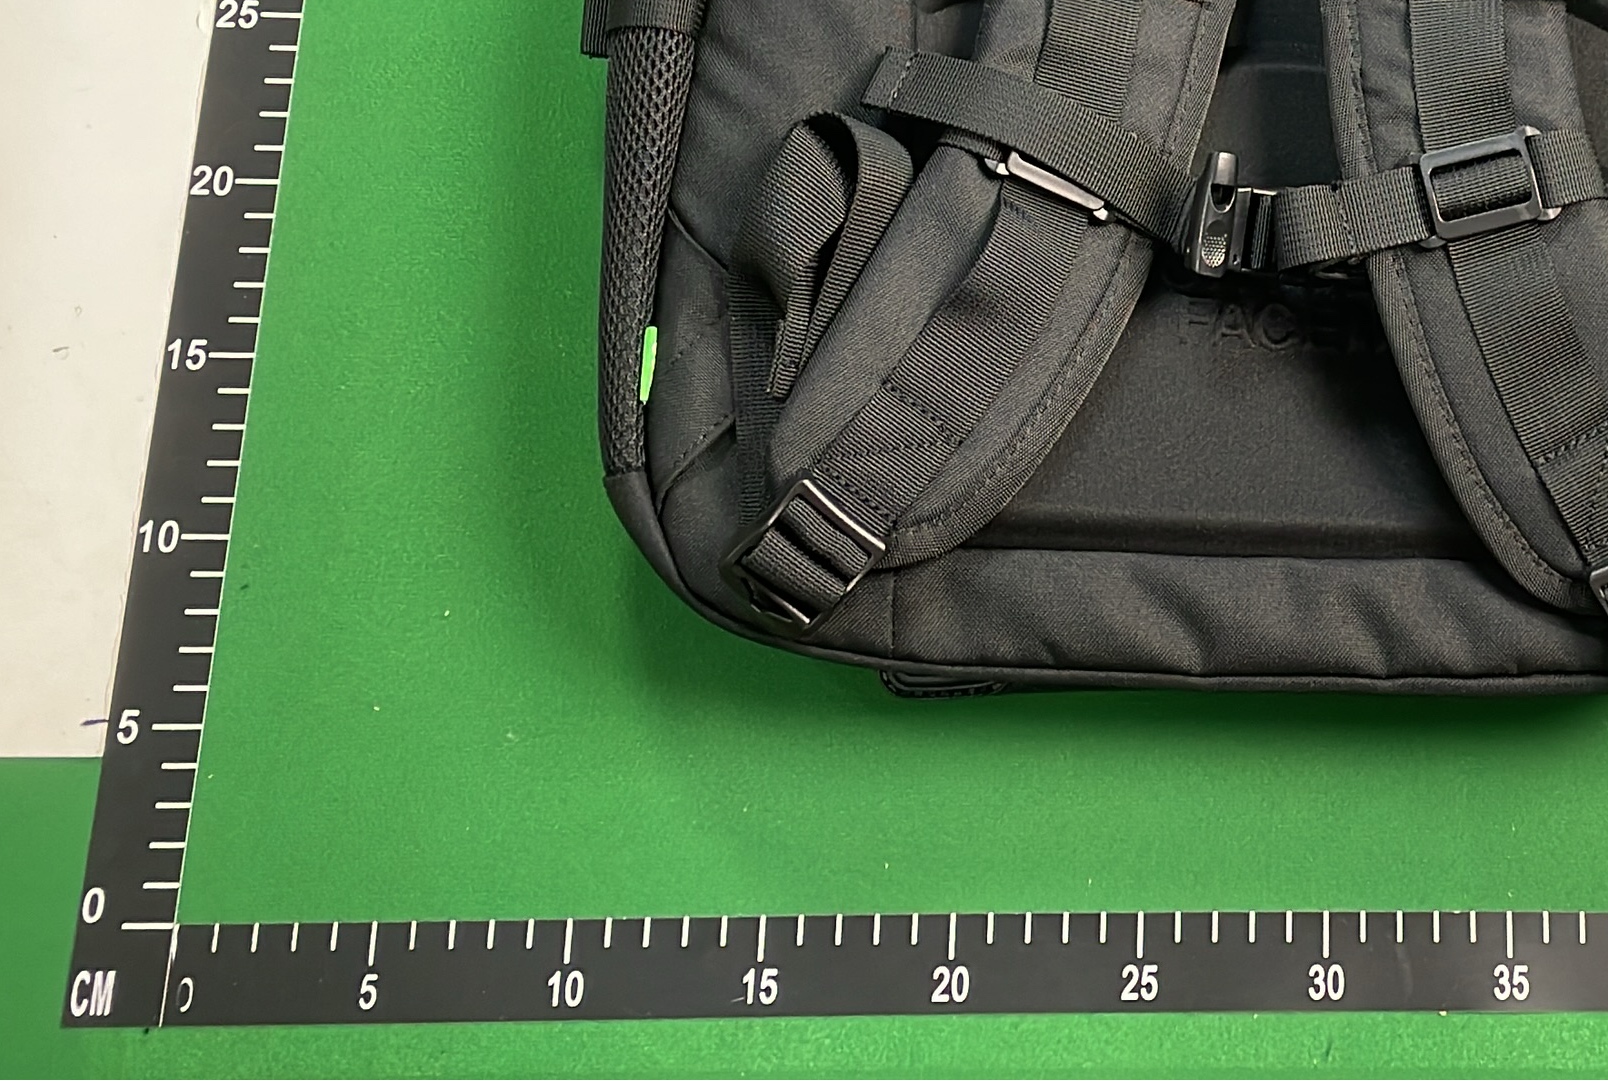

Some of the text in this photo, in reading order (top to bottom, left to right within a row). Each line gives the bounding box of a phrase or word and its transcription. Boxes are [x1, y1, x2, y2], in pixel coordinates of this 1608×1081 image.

[189, 164, 234, 197] 20
[167, 337, 208, 371] 15
[138, 519, 180, 554] 10
[116, 708, 141, 745] 5
[81, 886, 106, 924] 0
[70, 970, 117, 1017] CM
[358, 973, 379, 1010] 5
[547, 970, 585, 1008] 10
[742, 967, 779, 1005] 15
[930, 965, 970, 1003] 20
[1120, 963, 1159, 1001] 25
[1308, 963, 1345, 1001] 30
[1493, 963, 1530, 1001] 35
